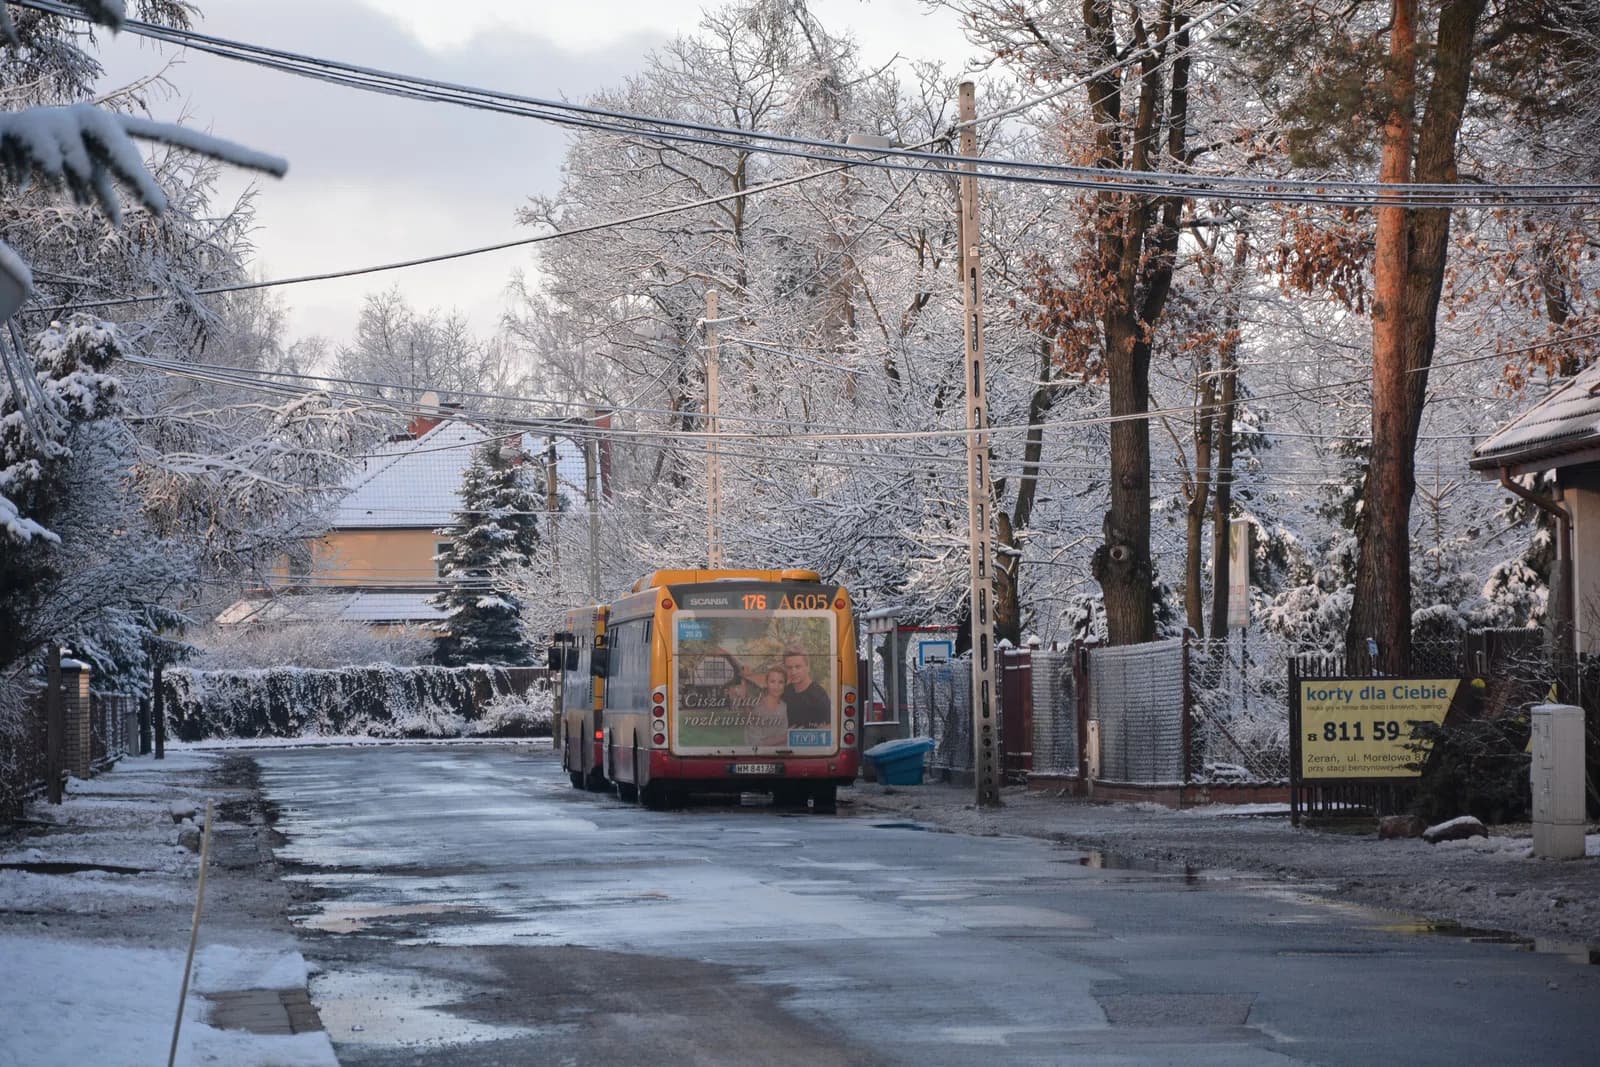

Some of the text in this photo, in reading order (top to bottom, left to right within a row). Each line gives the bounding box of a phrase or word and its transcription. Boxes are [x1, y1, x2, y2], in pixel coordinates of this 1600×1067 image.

[689, 597, 729, 606] SCANIA
[741, 594, 767, 610] 176
[778, 594, 828, 610] A605
[685, 692, 762, 708] Cisza nad
[1306, 684, 1448, 703] korty dla Ciebie
[684, 711, 783, 728] rozlewiskiem
[793, 733, 827, 745] TVP 1
[1323, 721, 1364, 742] 811
[1373, 721, 1400, 741] 59
[1347, 754, 1359, 763] ul.
[1363, 753, 1411, 763] Morelowa
[1307, 764, 1324, 773] przy
